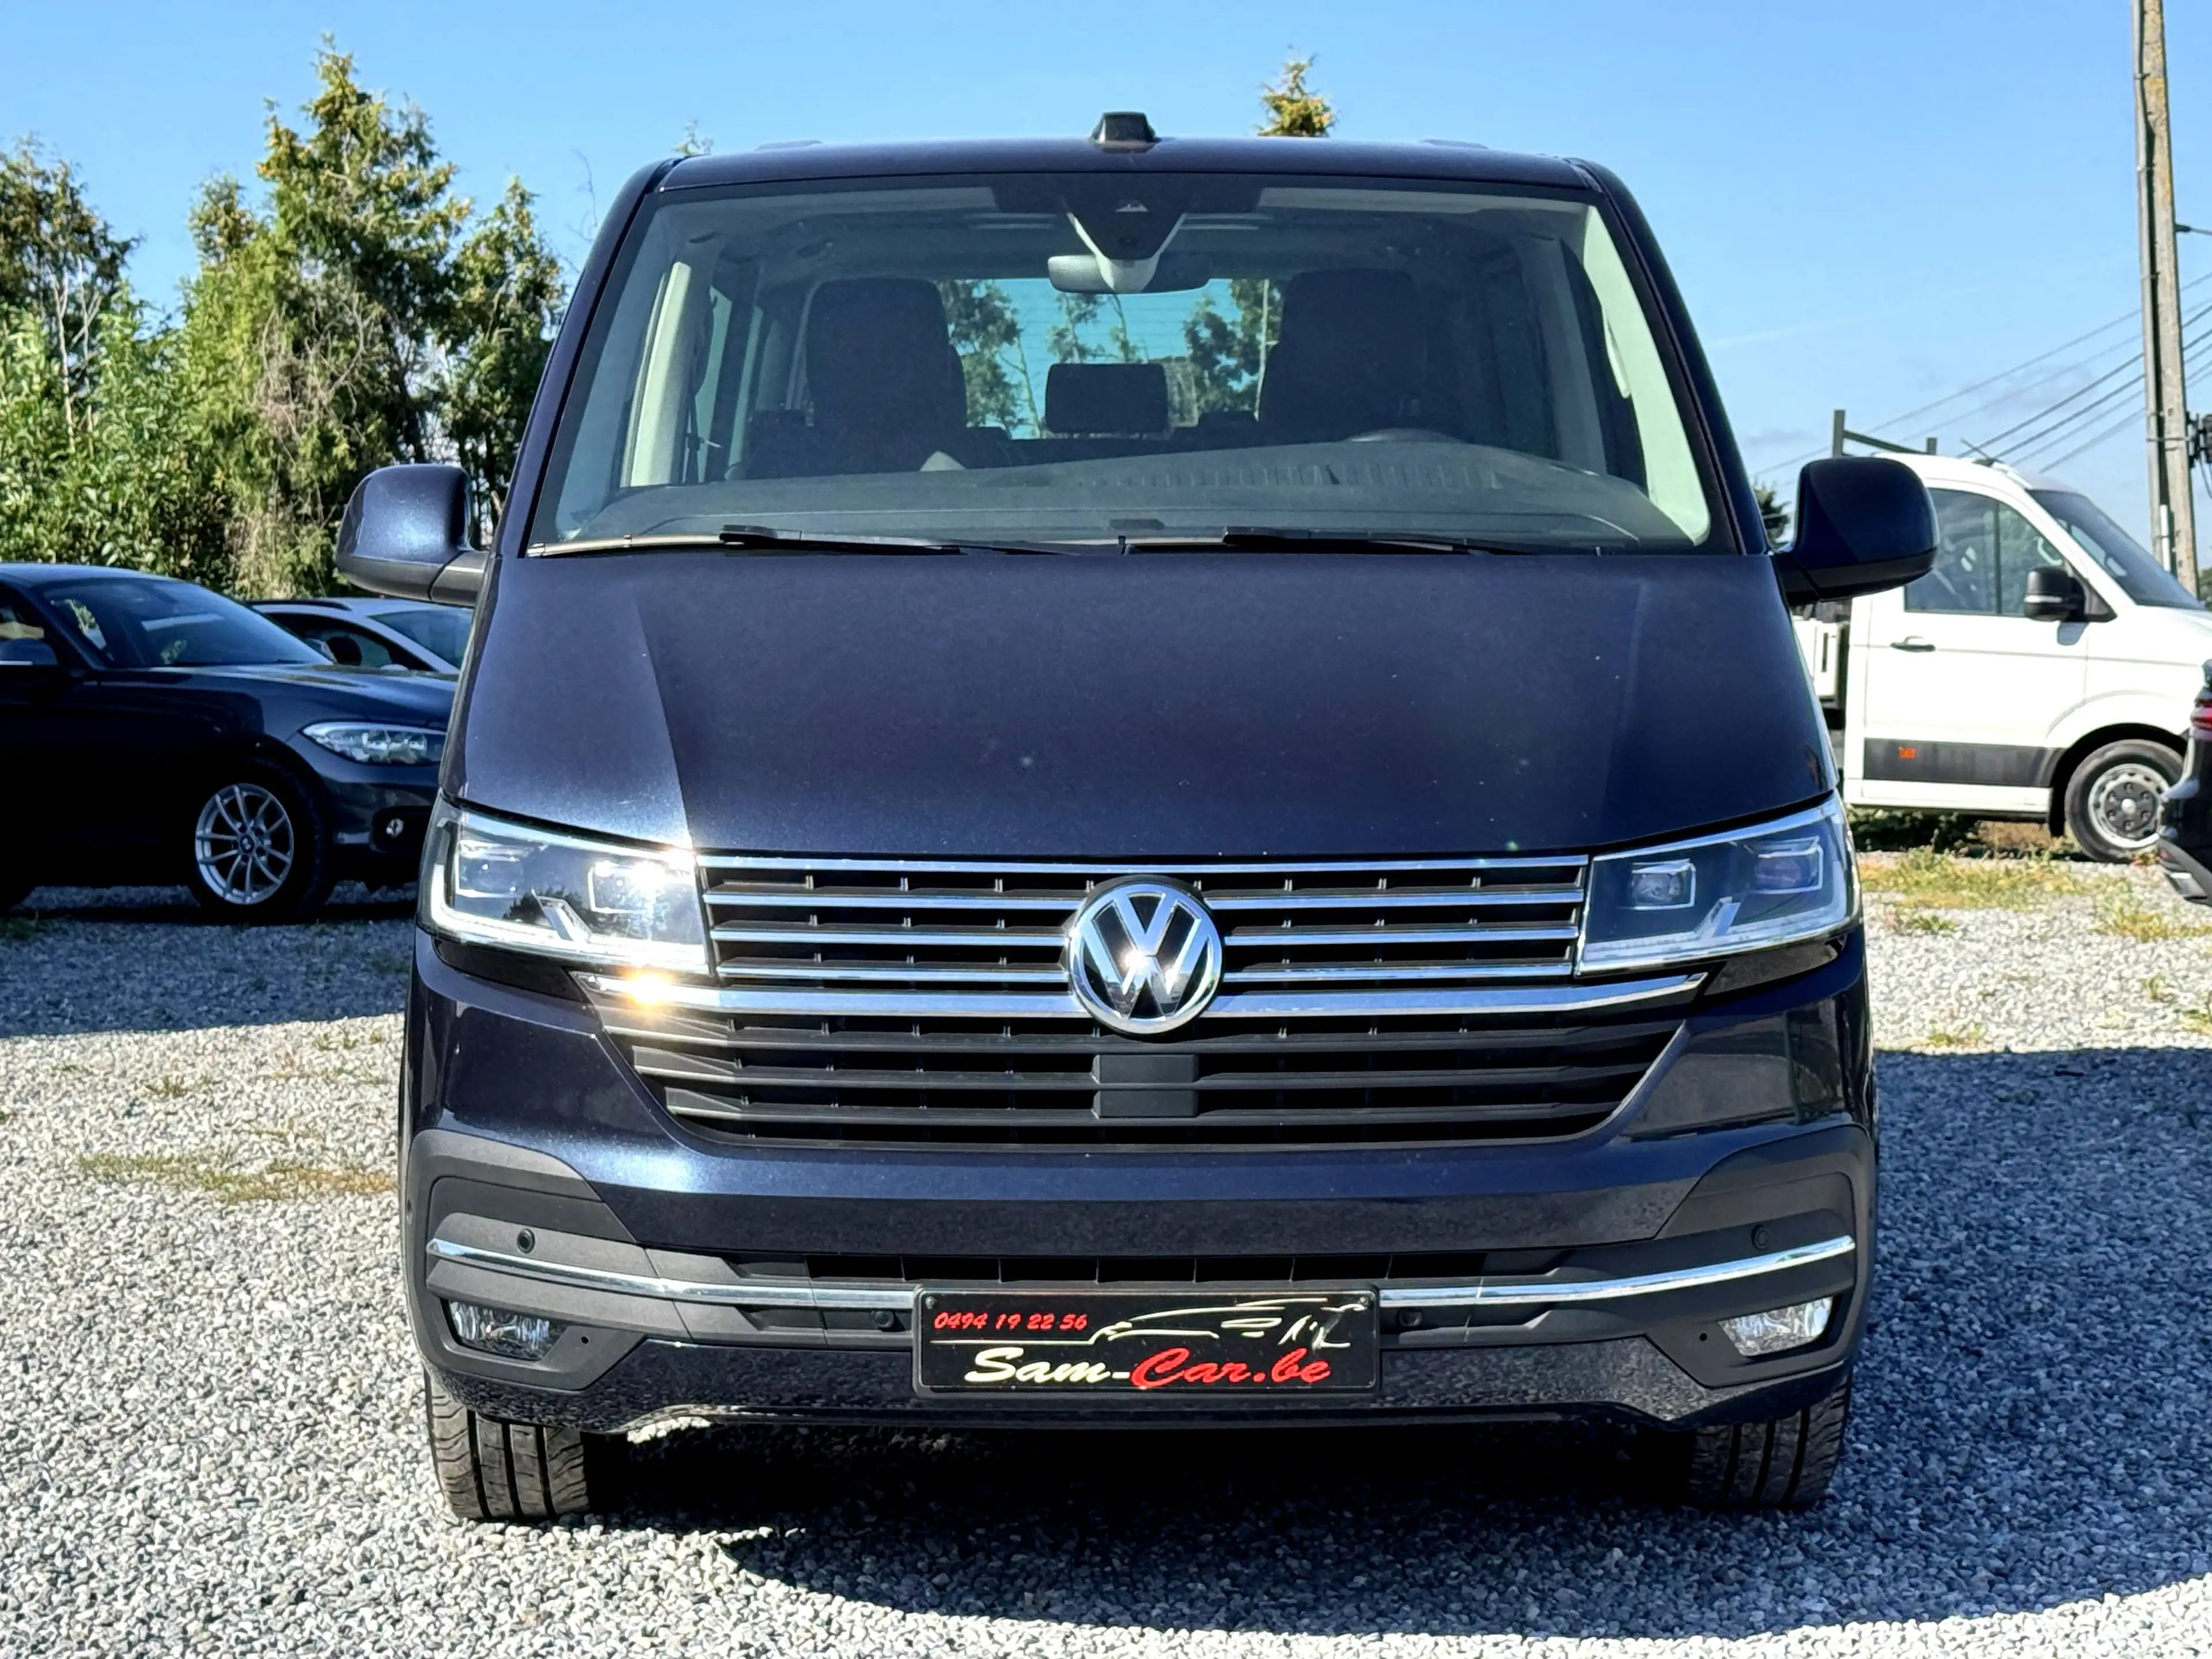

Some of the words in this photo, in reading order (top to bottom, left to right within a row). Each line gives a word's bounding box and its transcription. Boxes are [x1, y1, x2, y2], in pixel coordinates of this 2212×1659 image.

[1069, 883, 1222, 1035] VW
[933, 1311, 989, 1330] 0494
[995, 1312, 1022, 1330] 19
[1026, 1312, 1055, 1331] 22
[1059, 1312, 1088, 1331] 56
[964, 1346, 1332, 1389] Sam-Car.be
